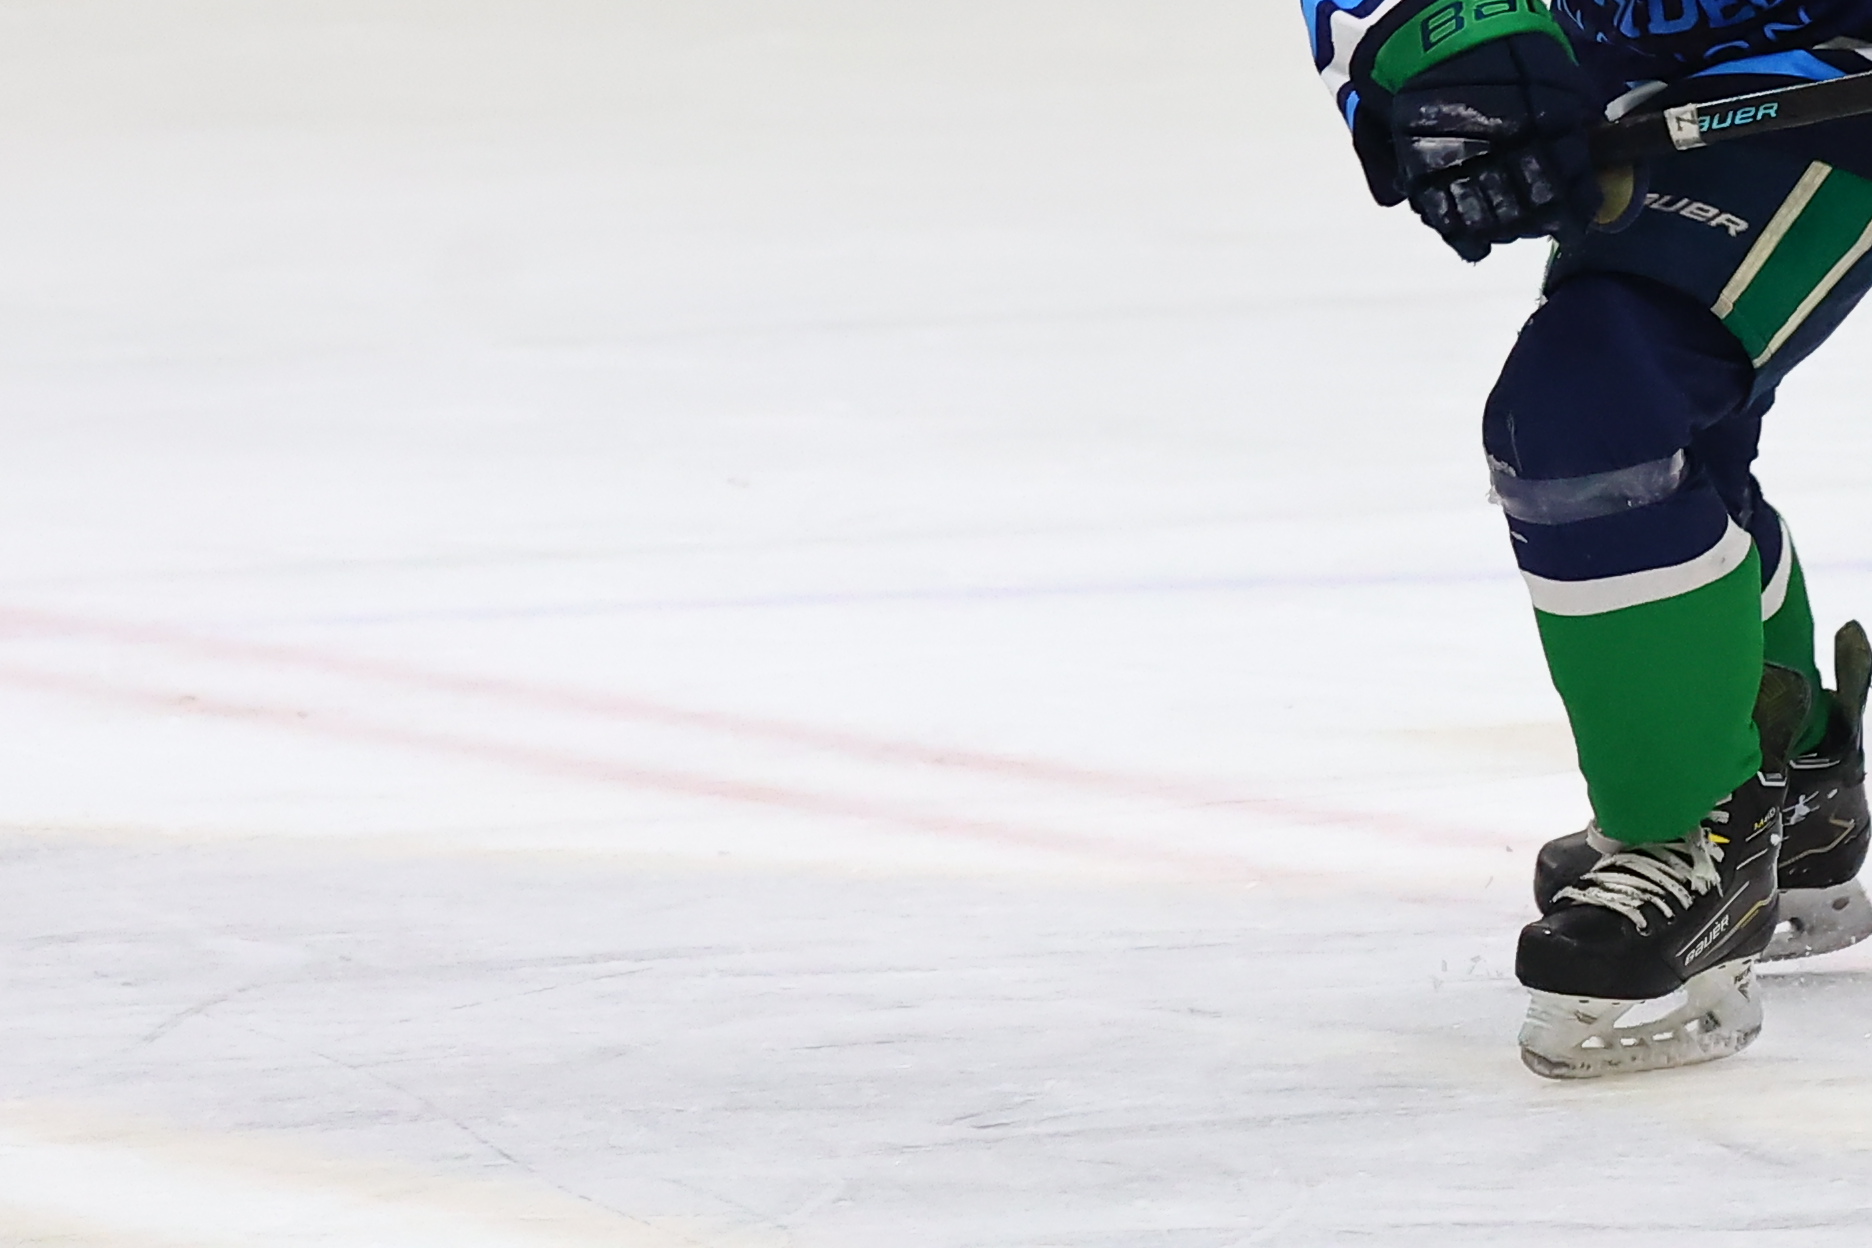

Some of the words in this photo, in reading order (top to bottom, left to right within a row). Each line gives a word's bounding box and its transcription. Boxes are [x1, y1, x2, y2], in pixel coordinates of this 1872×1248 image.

[1698, 102, 1779, 132] AUER
[1645, 192, 1749, 237] AUER
[1683, 913, 1730, 966] BAUER
